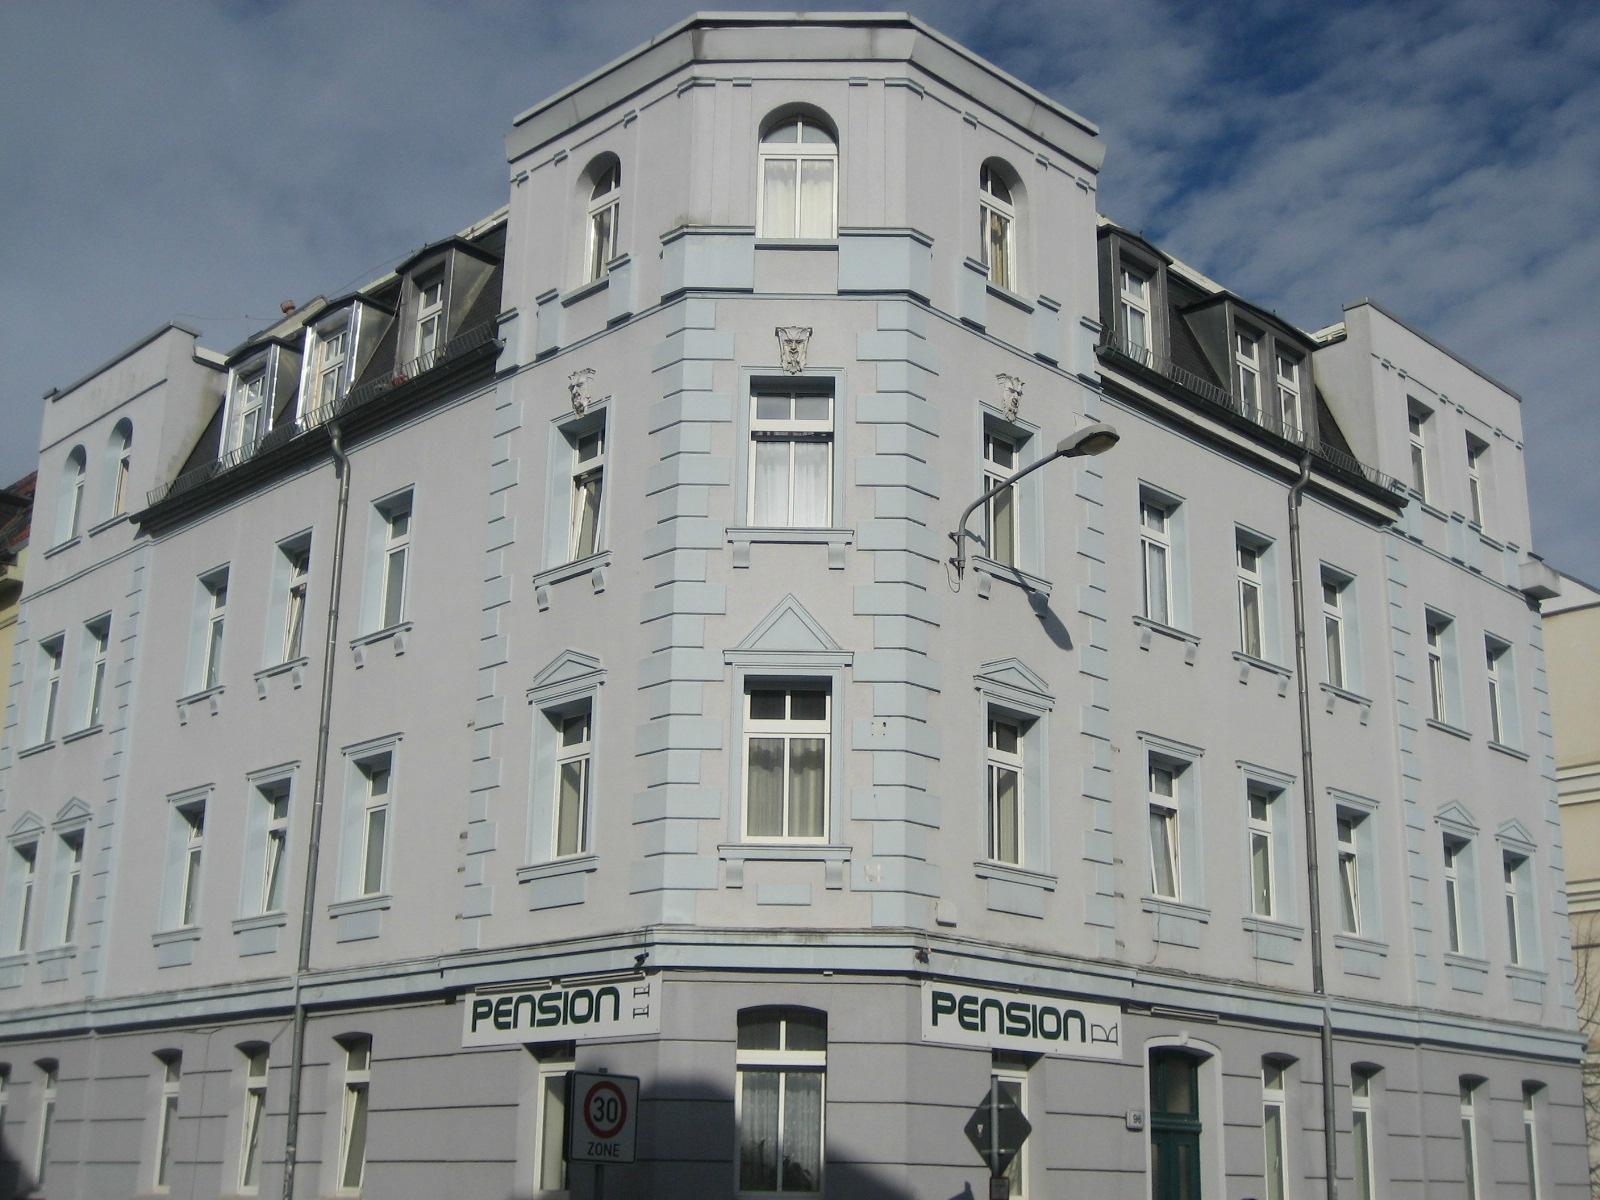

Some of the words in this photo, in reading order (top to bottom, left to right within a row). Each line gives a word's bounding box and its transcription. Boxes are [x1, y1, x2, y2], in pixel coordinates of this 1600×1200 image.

[471, 986, 621, 1033] PENSION
[931, 990, 1087, 1043] PENSION
[593, 1096, 618, 1124] 30
[587, 1142, 621, 1158] ZONE
